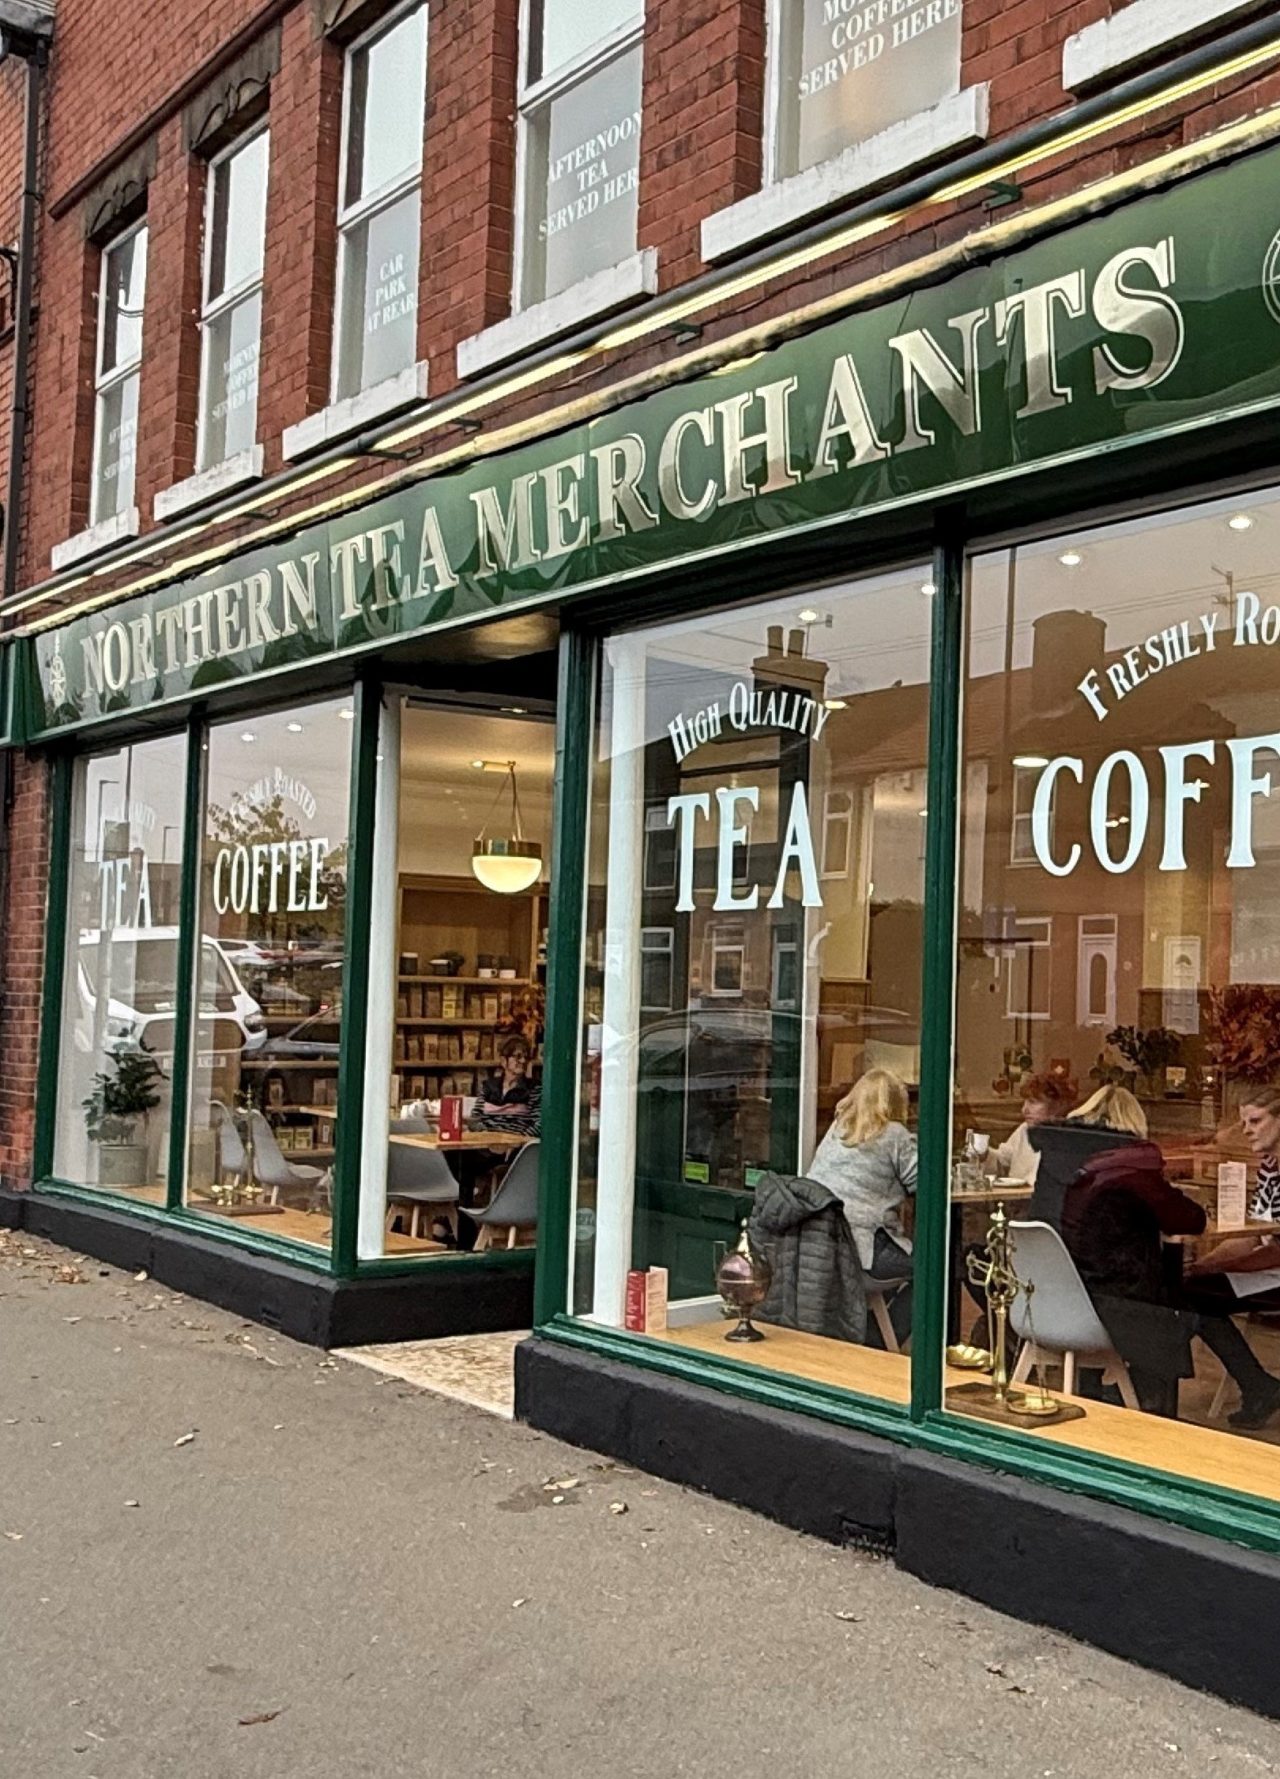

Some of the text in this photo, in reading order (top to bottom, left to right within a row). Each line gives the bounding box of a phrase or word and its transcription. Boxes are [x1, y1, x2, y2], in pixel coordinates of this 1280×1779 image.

[798, 0, 959, 101] SERVED HERE
[538, 167, 638, 242] SERVED HER
[577, 158, 609, 193] TEA
[375, 273, 407, 307] PARK
[380, 253, 404, 282] CAR
[80, 235, 1185, 699] NORTHERN TEA MERCHANTS
[1077, 611, 1219, 721] FRESHLY
[667, 681, 832, 765] HIGH QUALITY
[213, 837, 329, 915] COFFEE
[666, 780, 824, 912] TEA
[100, 853, 152, 931] TEA
